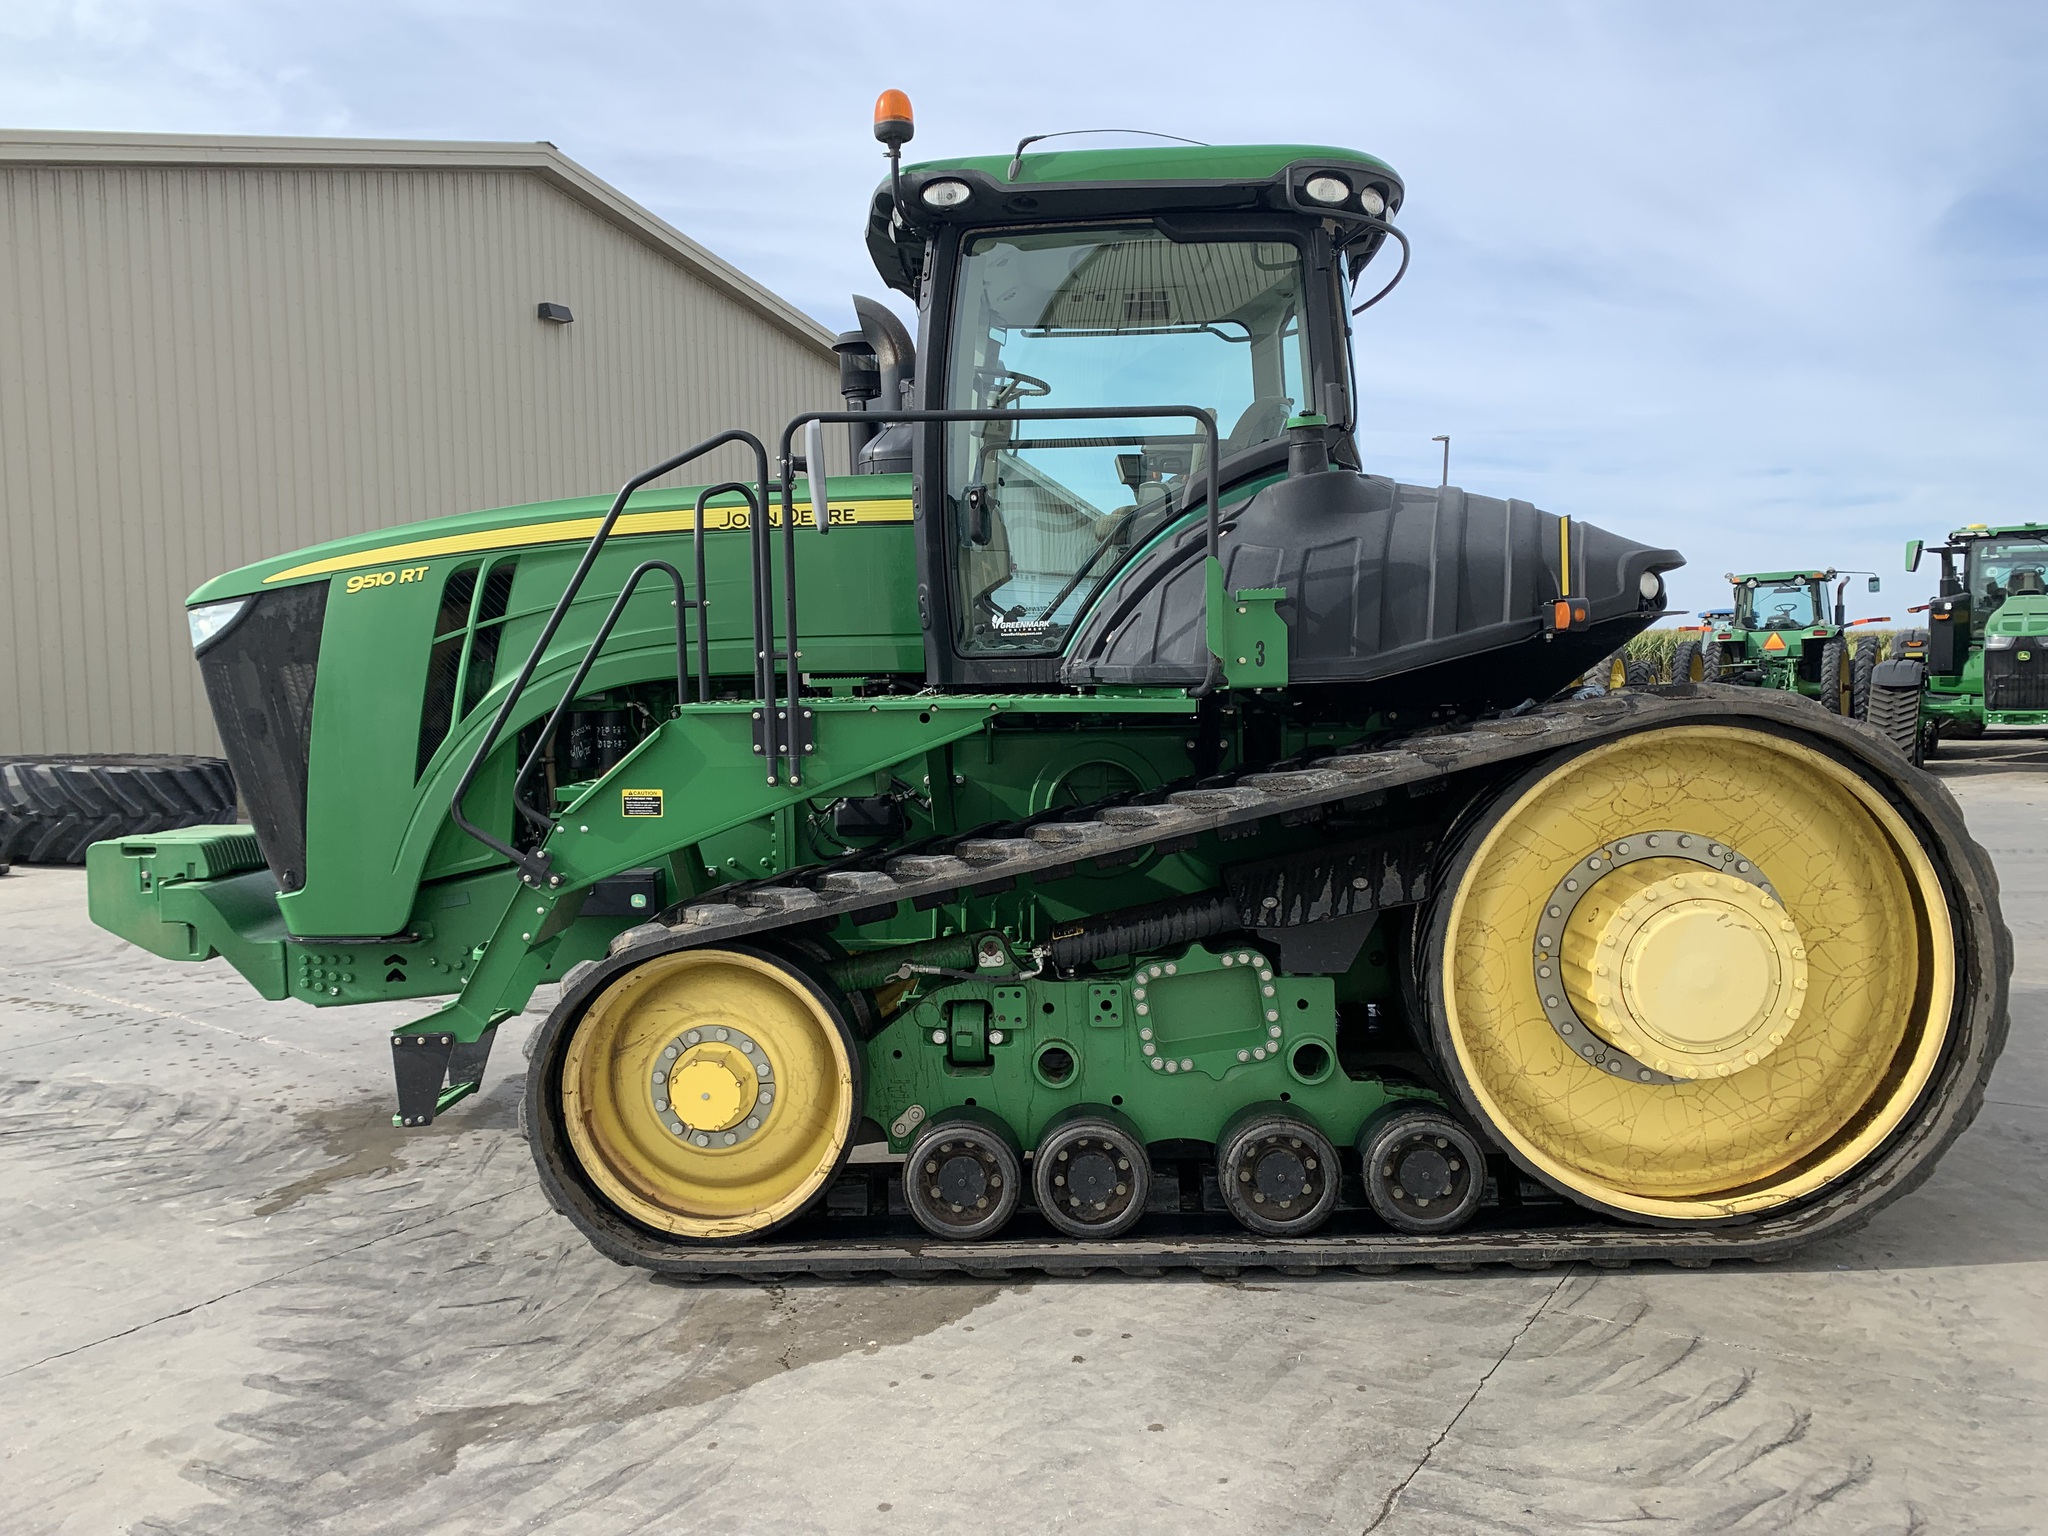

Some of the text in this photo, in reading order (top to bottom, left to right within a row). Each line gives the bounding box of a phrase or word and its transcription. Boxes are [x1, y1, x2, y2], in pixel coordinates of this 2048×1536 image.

[719, 508, 855, 527] JON ERE
[346, 566, 430, 594] 9510 RT
[1000, 620, 1050, 629] GREENMARK
[1255, 640, 1265, 667] 3
